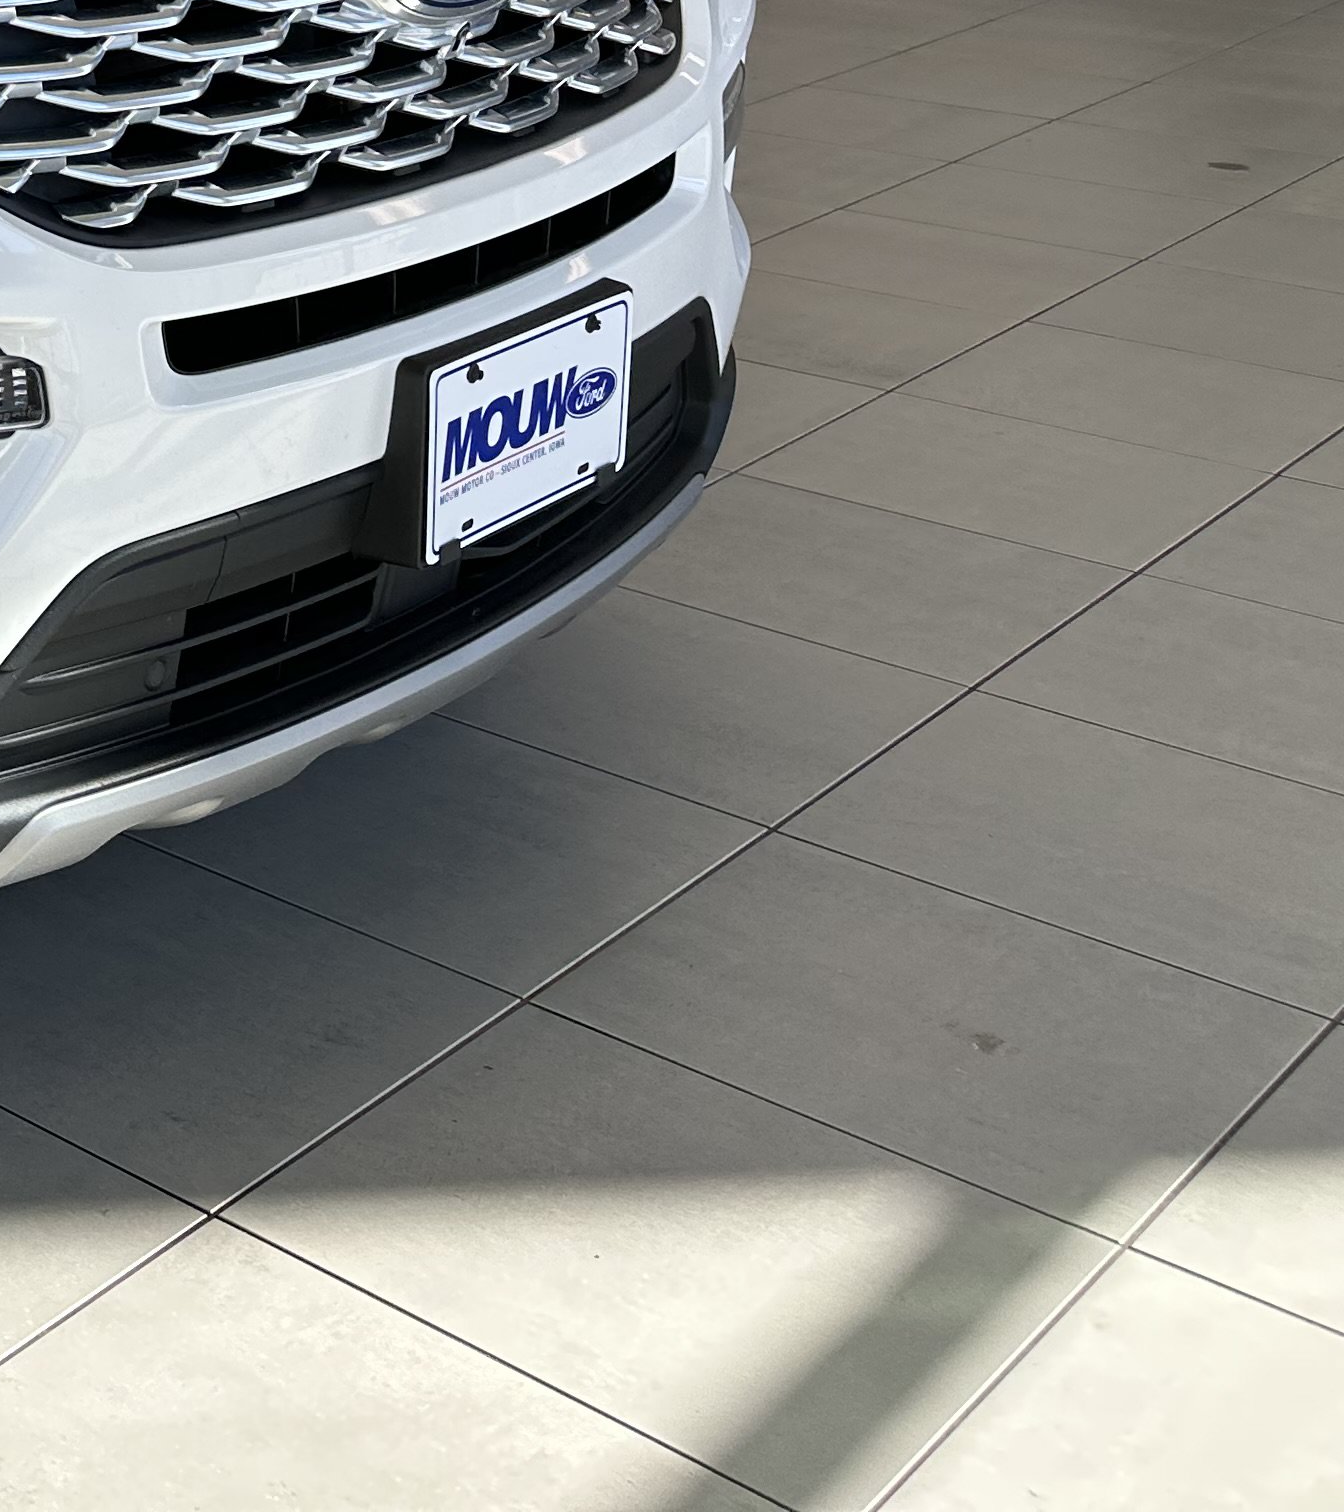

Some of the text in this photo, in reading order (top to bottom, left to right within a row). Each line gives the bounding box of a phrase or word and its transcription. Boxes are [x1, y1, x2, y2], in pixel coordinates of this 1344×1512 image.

[441, 364, 578, 483] MOUW
[462, 475, 483, 495] MOTOR
[485, 470, 494, 483] CO
[549, 438, 564, 453] IOWA
